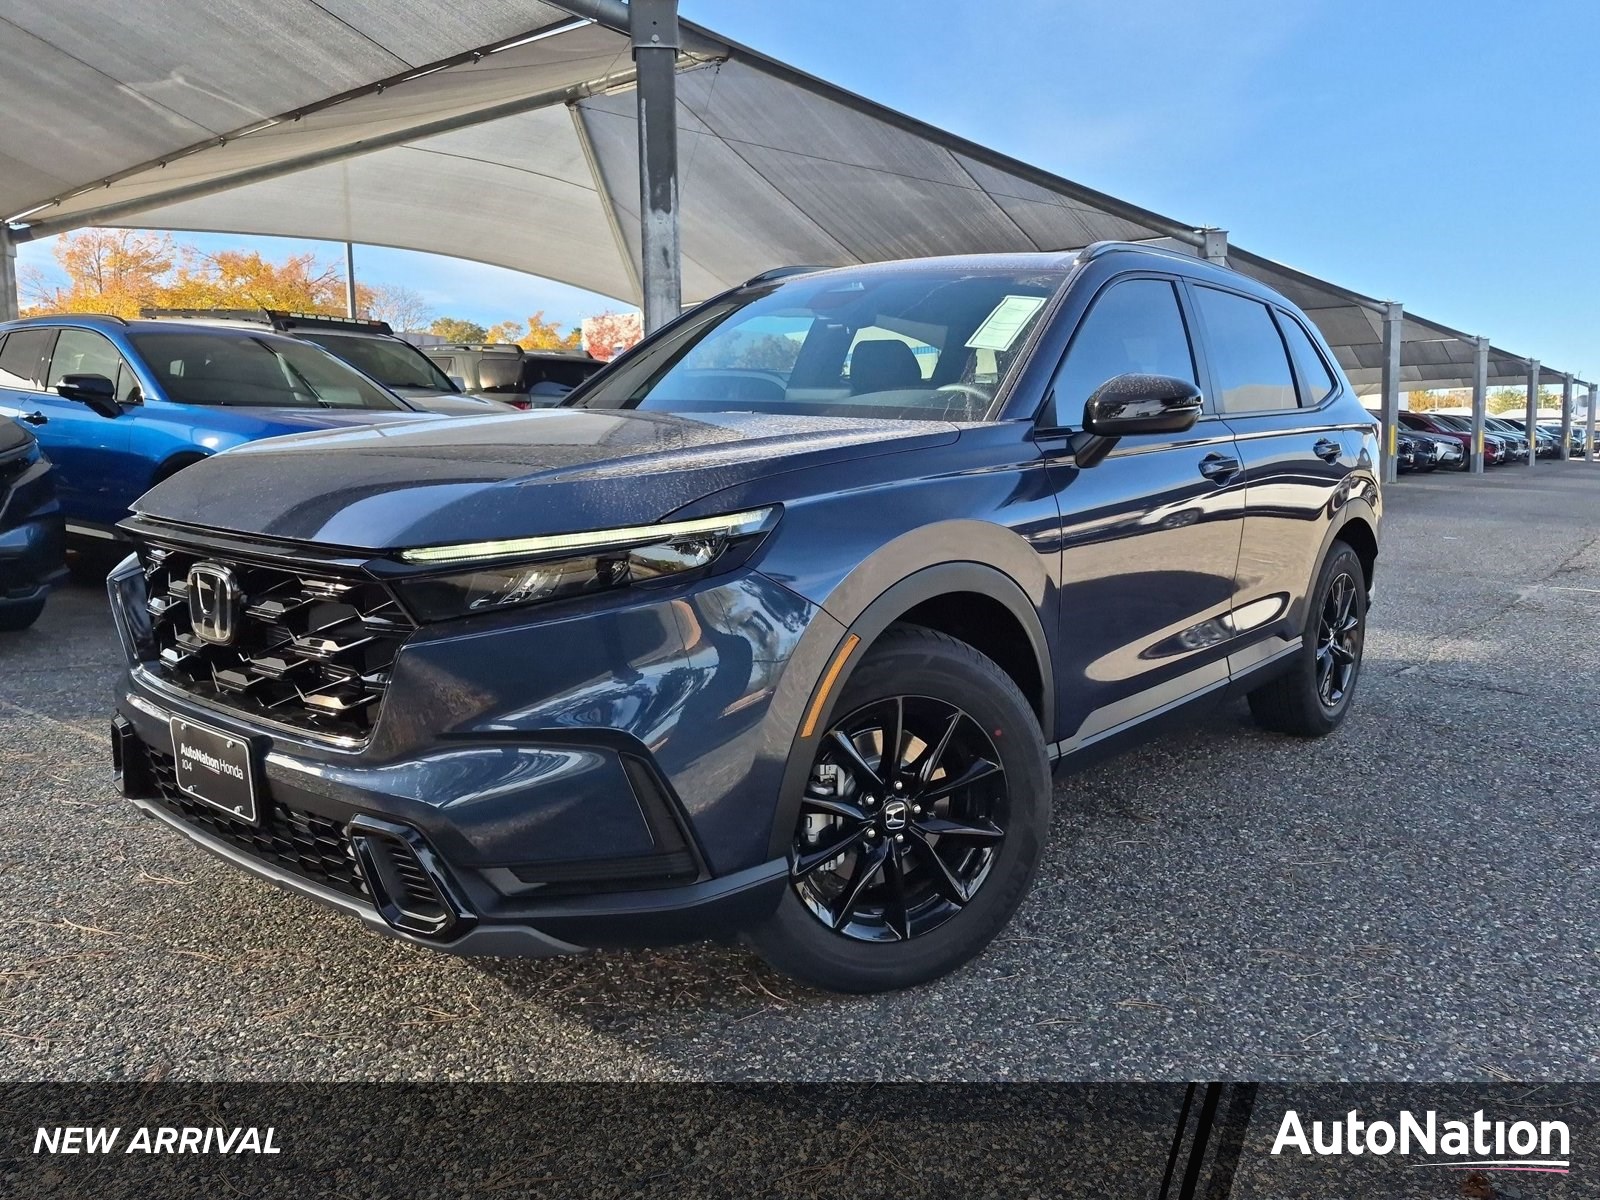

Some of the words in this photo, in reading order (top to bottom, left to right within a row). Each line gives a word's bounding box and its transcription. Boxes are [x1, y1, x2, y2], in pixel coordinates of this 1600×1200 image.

[180, 742, 220, 771] AutoNation
[219, 759, 244, 780] Honda
[181, 759, 193, 772] 104
